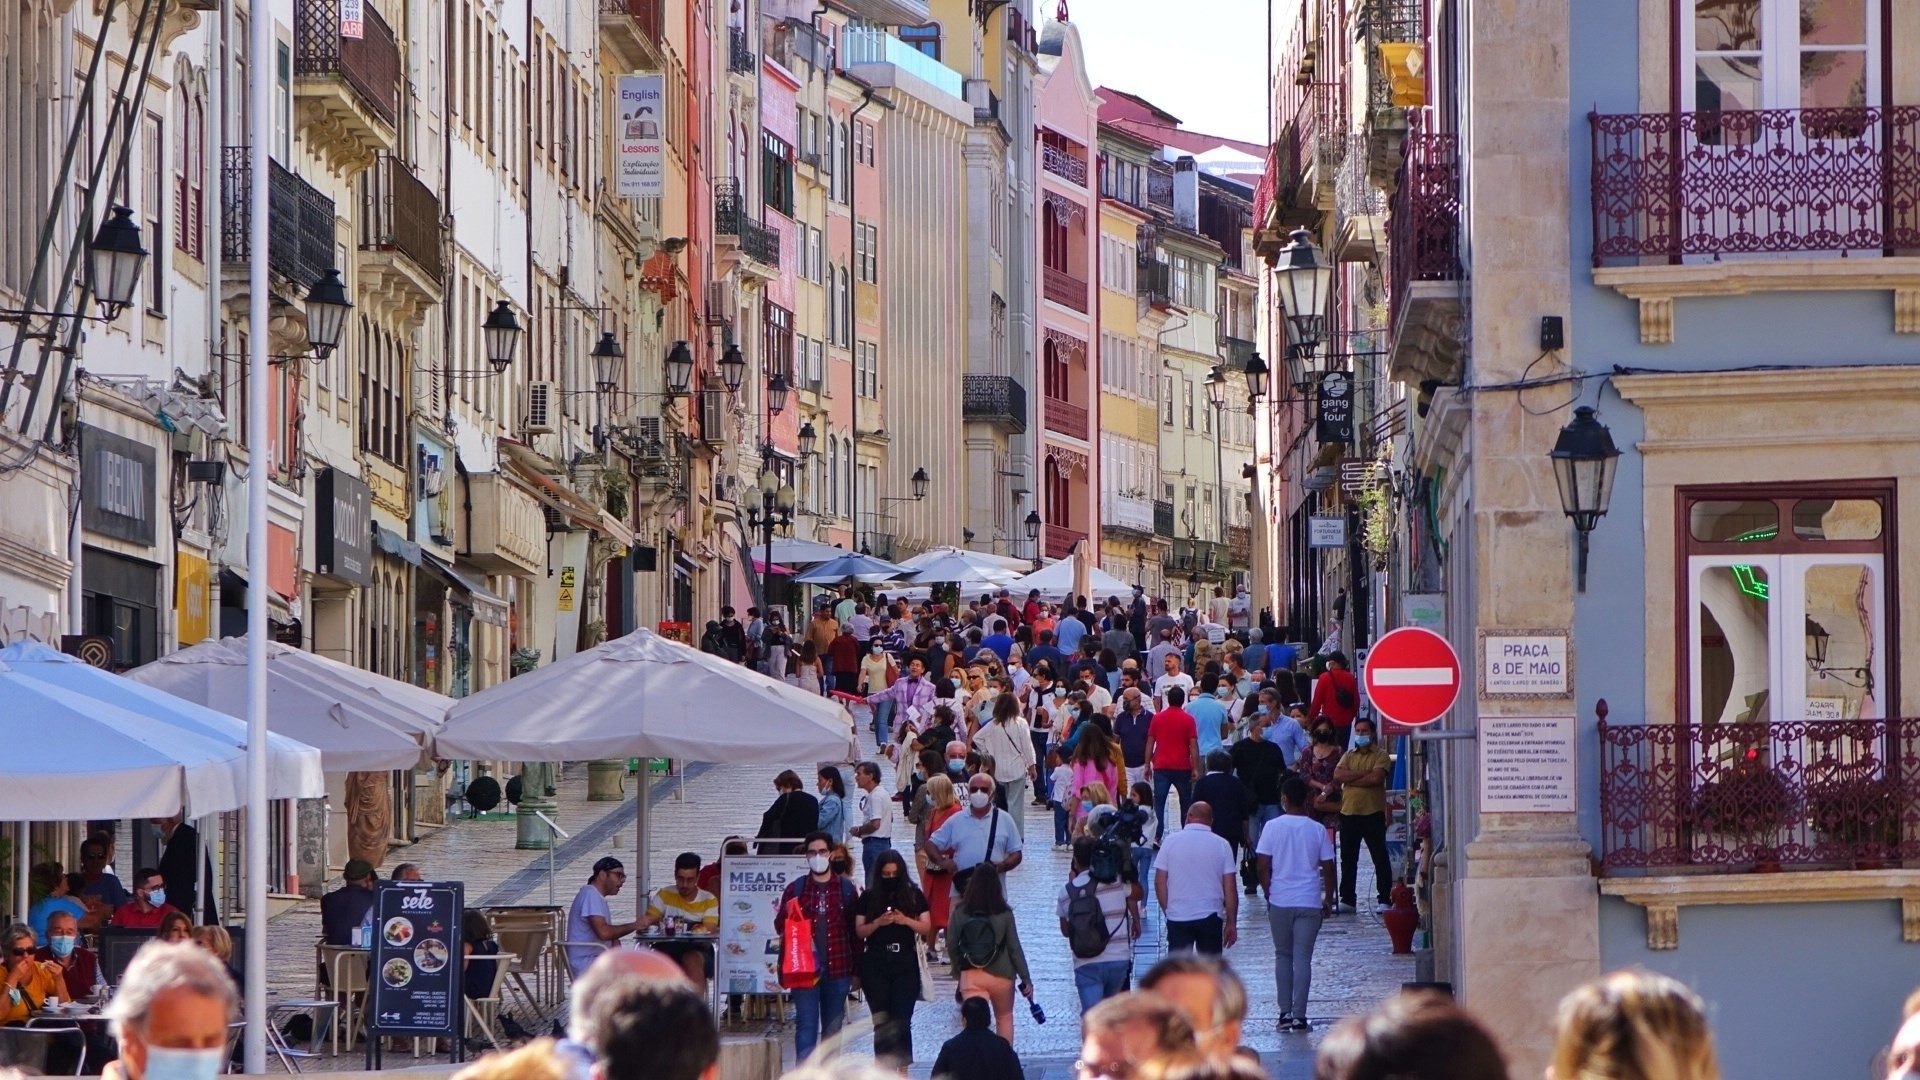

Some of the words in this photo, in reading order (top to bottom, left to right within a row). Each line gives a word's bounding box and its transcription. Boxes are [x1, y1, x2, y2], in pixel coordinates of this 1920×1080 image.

[344, 10, 359, 20] 919
[622, 90, 660, 101] English
[622, 144, 659, 153] Lessons
[622, 160, 659, 169] Explicações
[623, 168, 659, 176] Individuais
[1321, 399, 1349, 409] gang
[1324, 412, 1346, 421] four
[1504, 644, 1549, 658] PRAÇA
[1492, 662, 1500, 675] 8
[1505, 662, 1524, 675] DE
[1529, 662, 1561, 675] MAIO
[729, 871, 786, 884] MEALS
[729, 884, 785, 892] DESSERTS
[791, 925, 798, 936] TV
[791, 936, 799, 973] Vodafone
